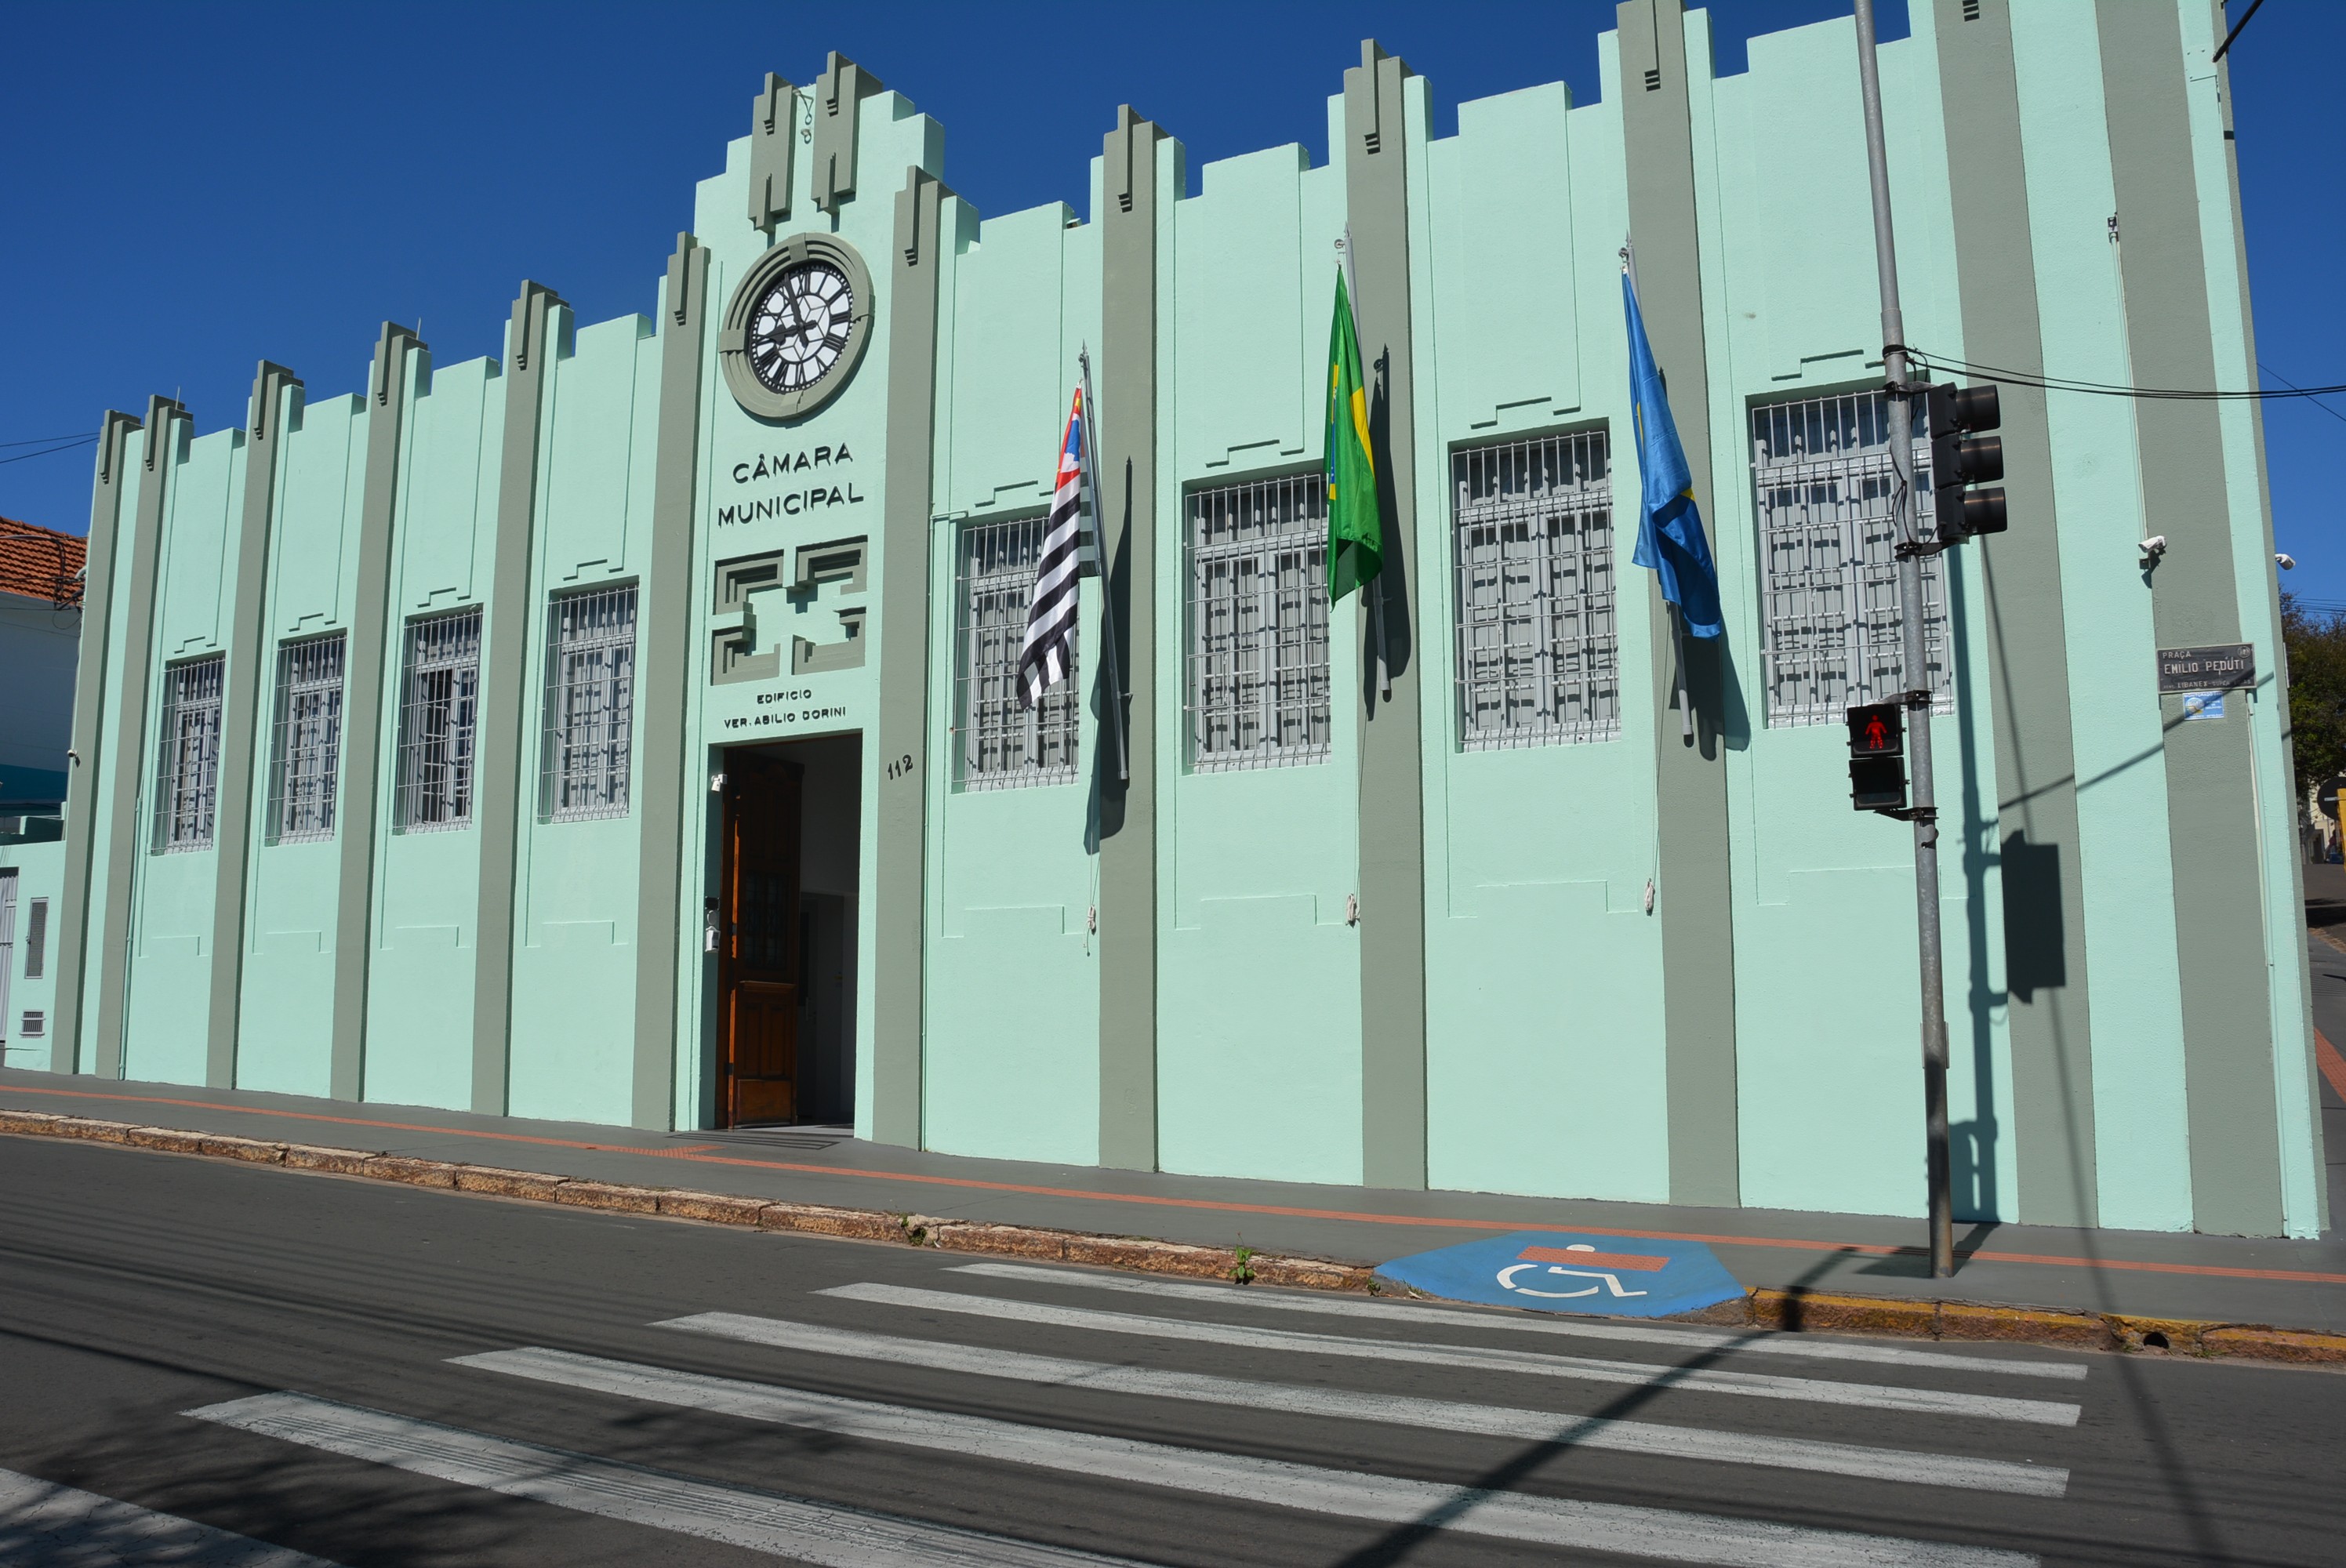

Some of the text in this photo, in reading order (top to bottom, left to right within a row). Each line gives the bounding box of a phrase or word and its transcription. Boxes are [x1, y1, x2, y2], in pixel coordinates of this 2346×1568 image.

[732, 442, 853, 484] CÂMARA
[718, 482, 864, 528] MUNICIPAL
[2163, 651, 2192, 659] PRAÇA
[757, 689, 812, 705] EDIFICIO
[754, 713, 796, 726] ABILIO
[802, 706, 846, 720] DORINI
[888, 754, 913, 781] 112
